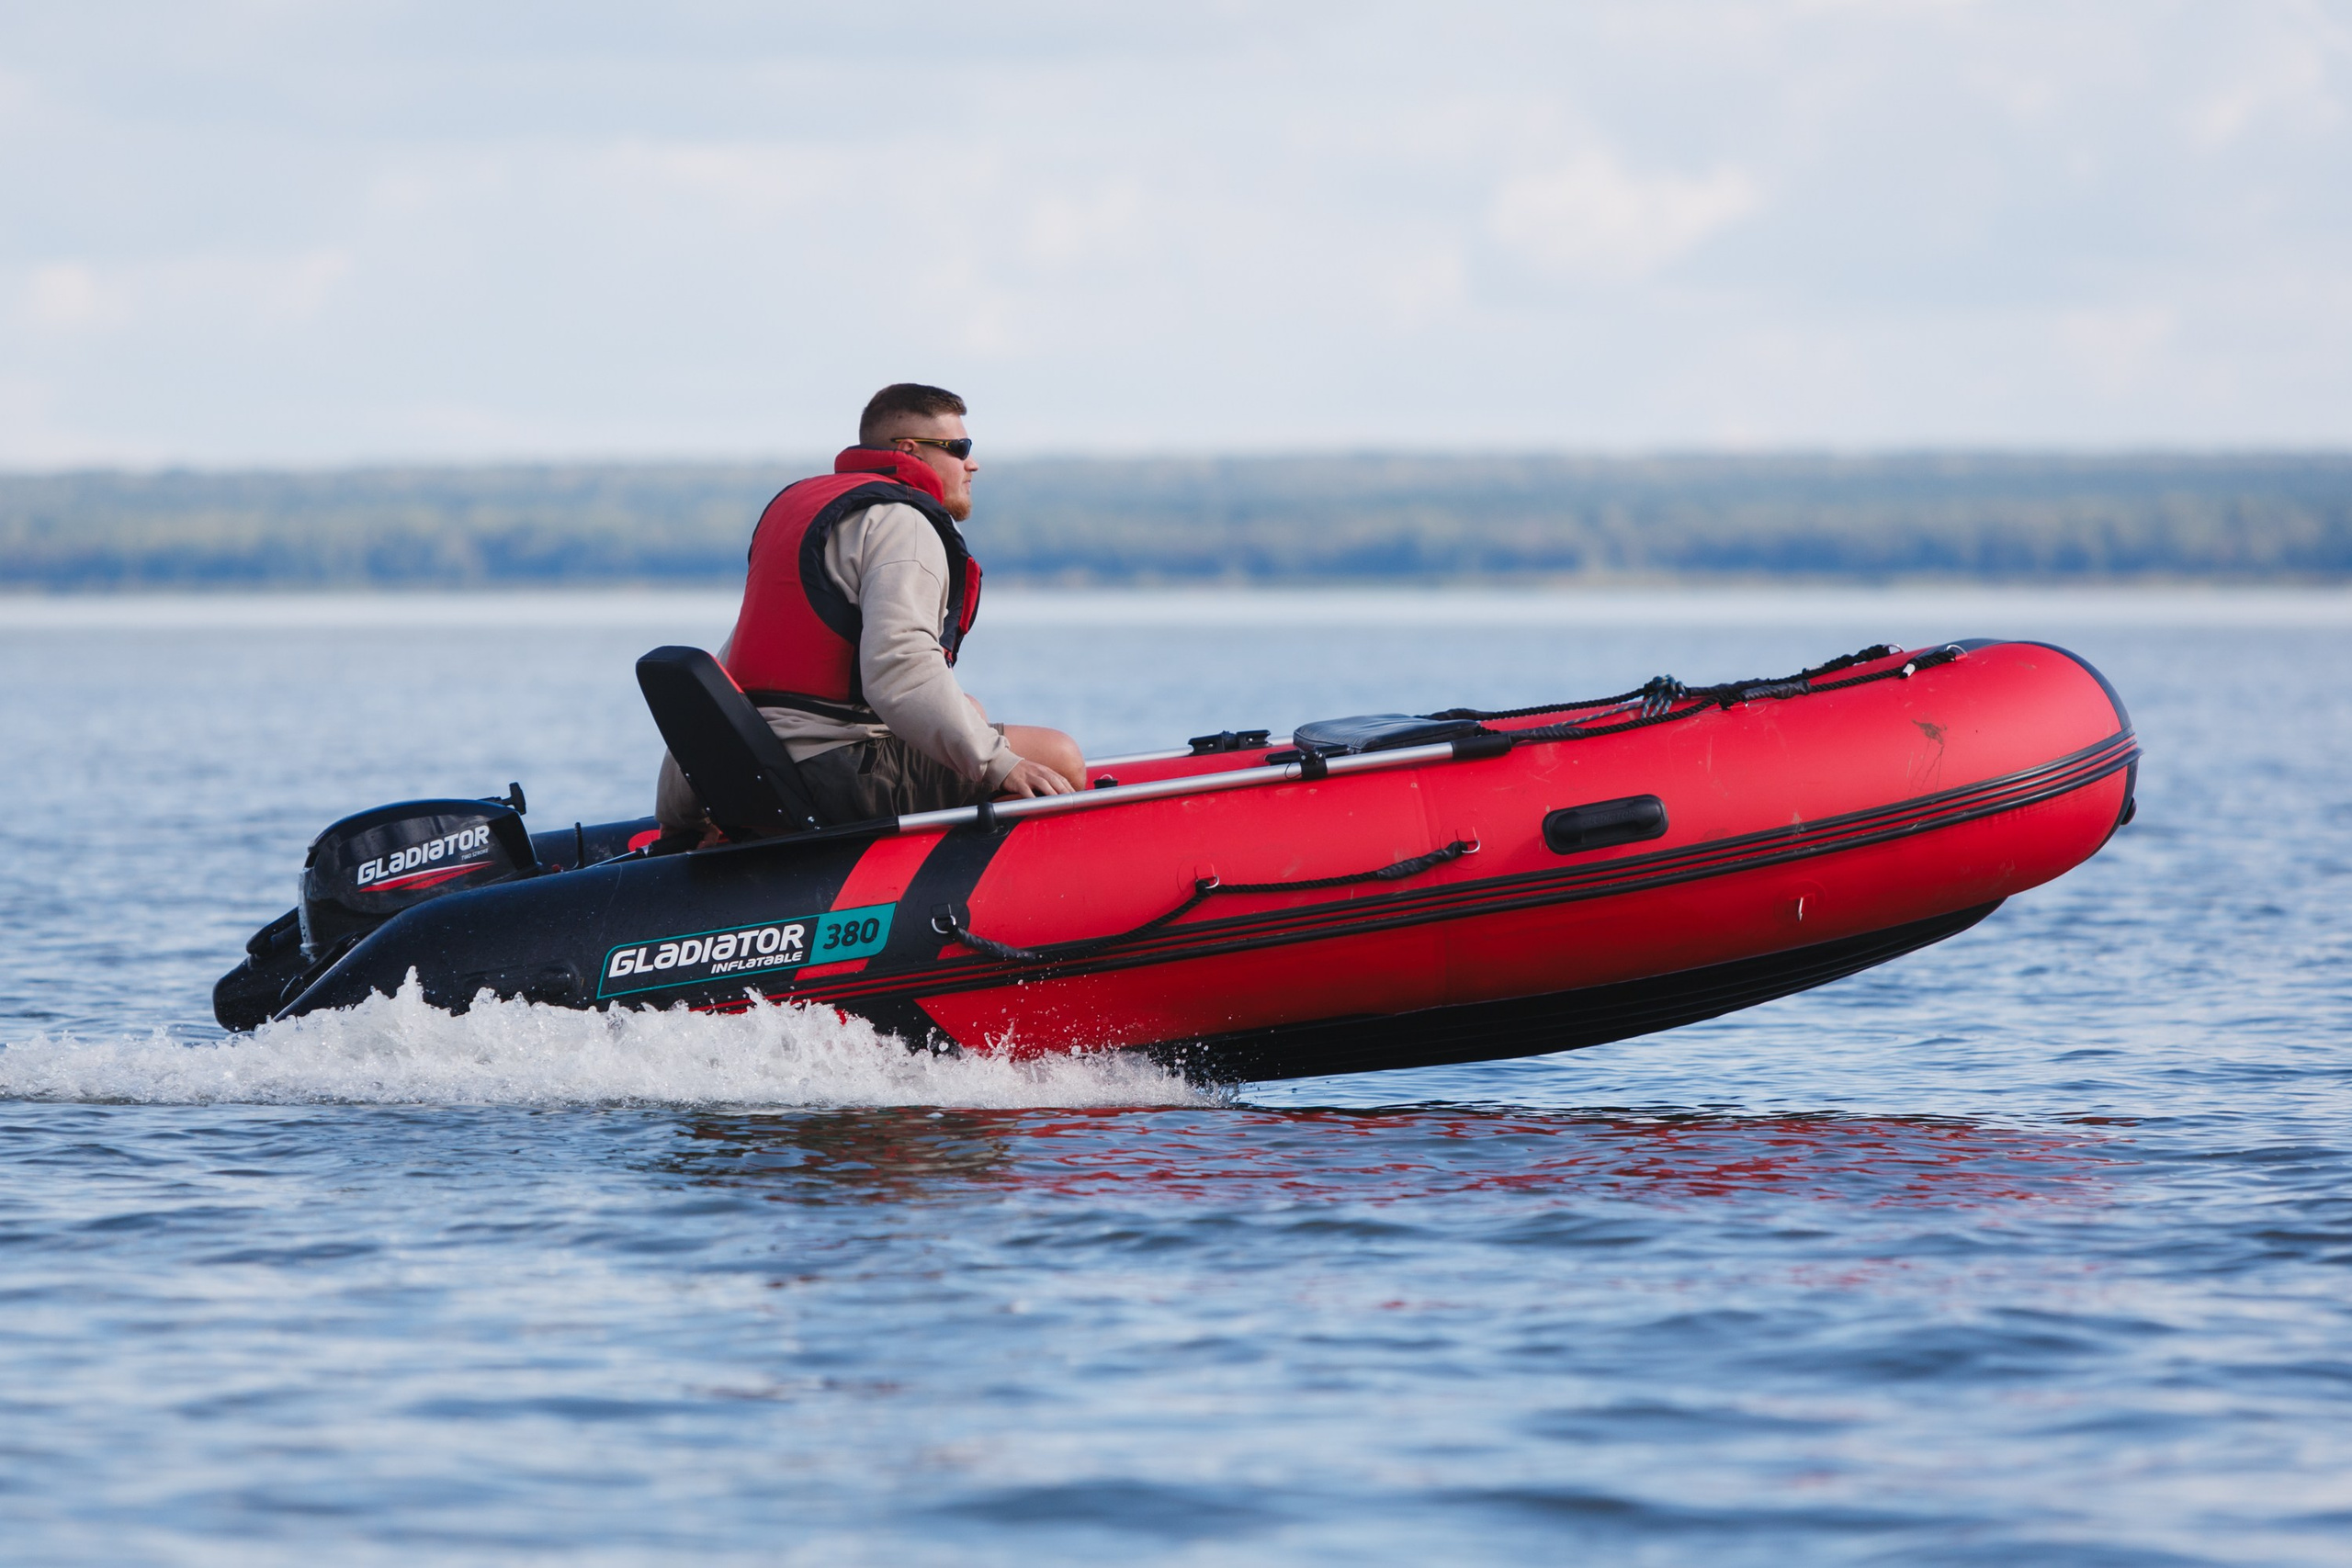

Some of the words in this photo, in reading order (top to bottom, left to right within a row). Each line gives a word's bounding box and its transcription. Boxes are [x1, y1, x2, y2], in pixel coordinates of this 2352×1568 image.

[356, 825, 490, 886] GLADIATOR
[608, 923, 805, 978] GLADIATOR
[822, 918, 880, 950] 380
[710, 951, 803, 974] INFLATABLE
